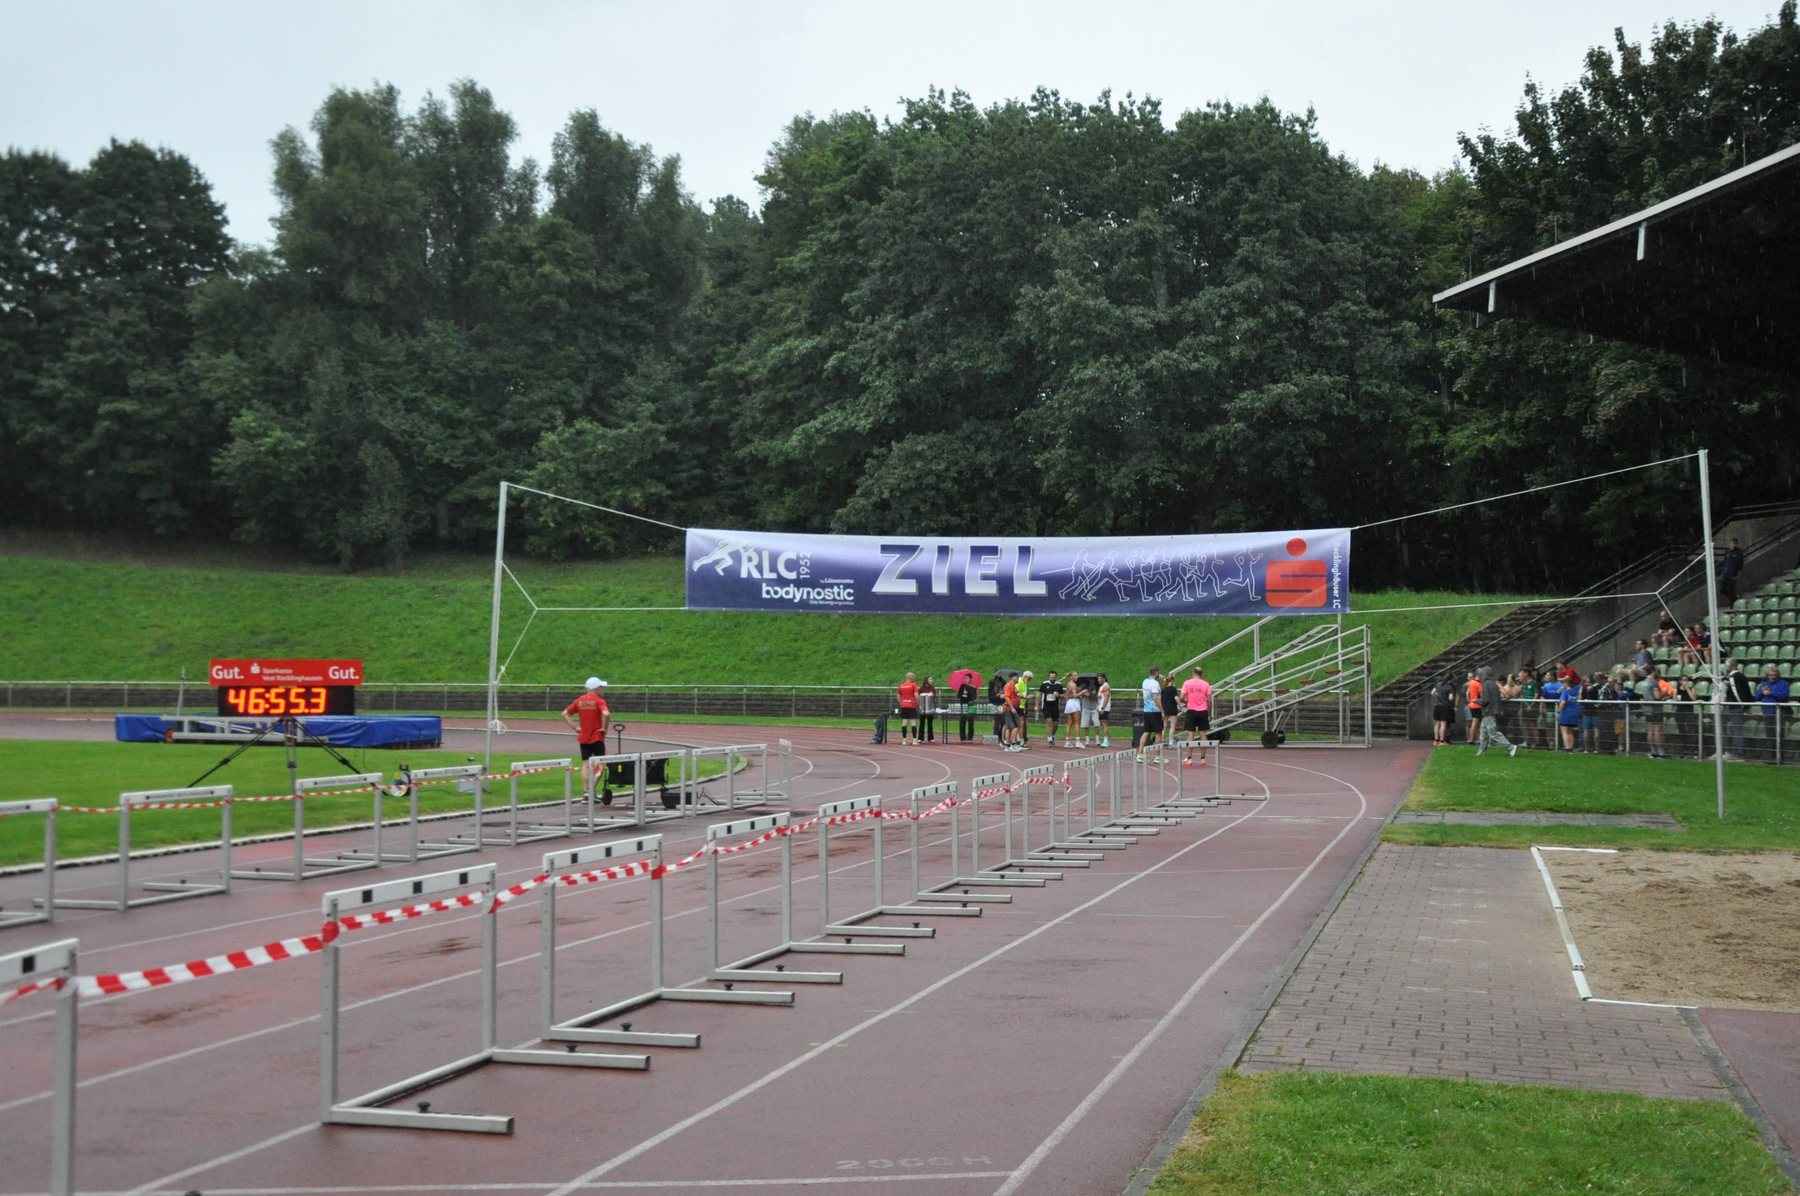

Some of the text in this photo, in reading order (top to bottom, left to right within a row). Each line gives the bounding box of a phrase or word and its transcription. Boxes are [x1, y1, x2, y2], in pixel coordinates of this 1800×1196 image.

[740, 550, 798, 579] RLC
[799, 551, 811, 579] 1952
[871, 543, 1047, 596] ZIEL
[762, 582, 854, 603] bodynostic
[1332, 599, 1341, 609] LC
[211, 665, 245, 680] Gut.
[328, 665, 360, 680] Gut.
